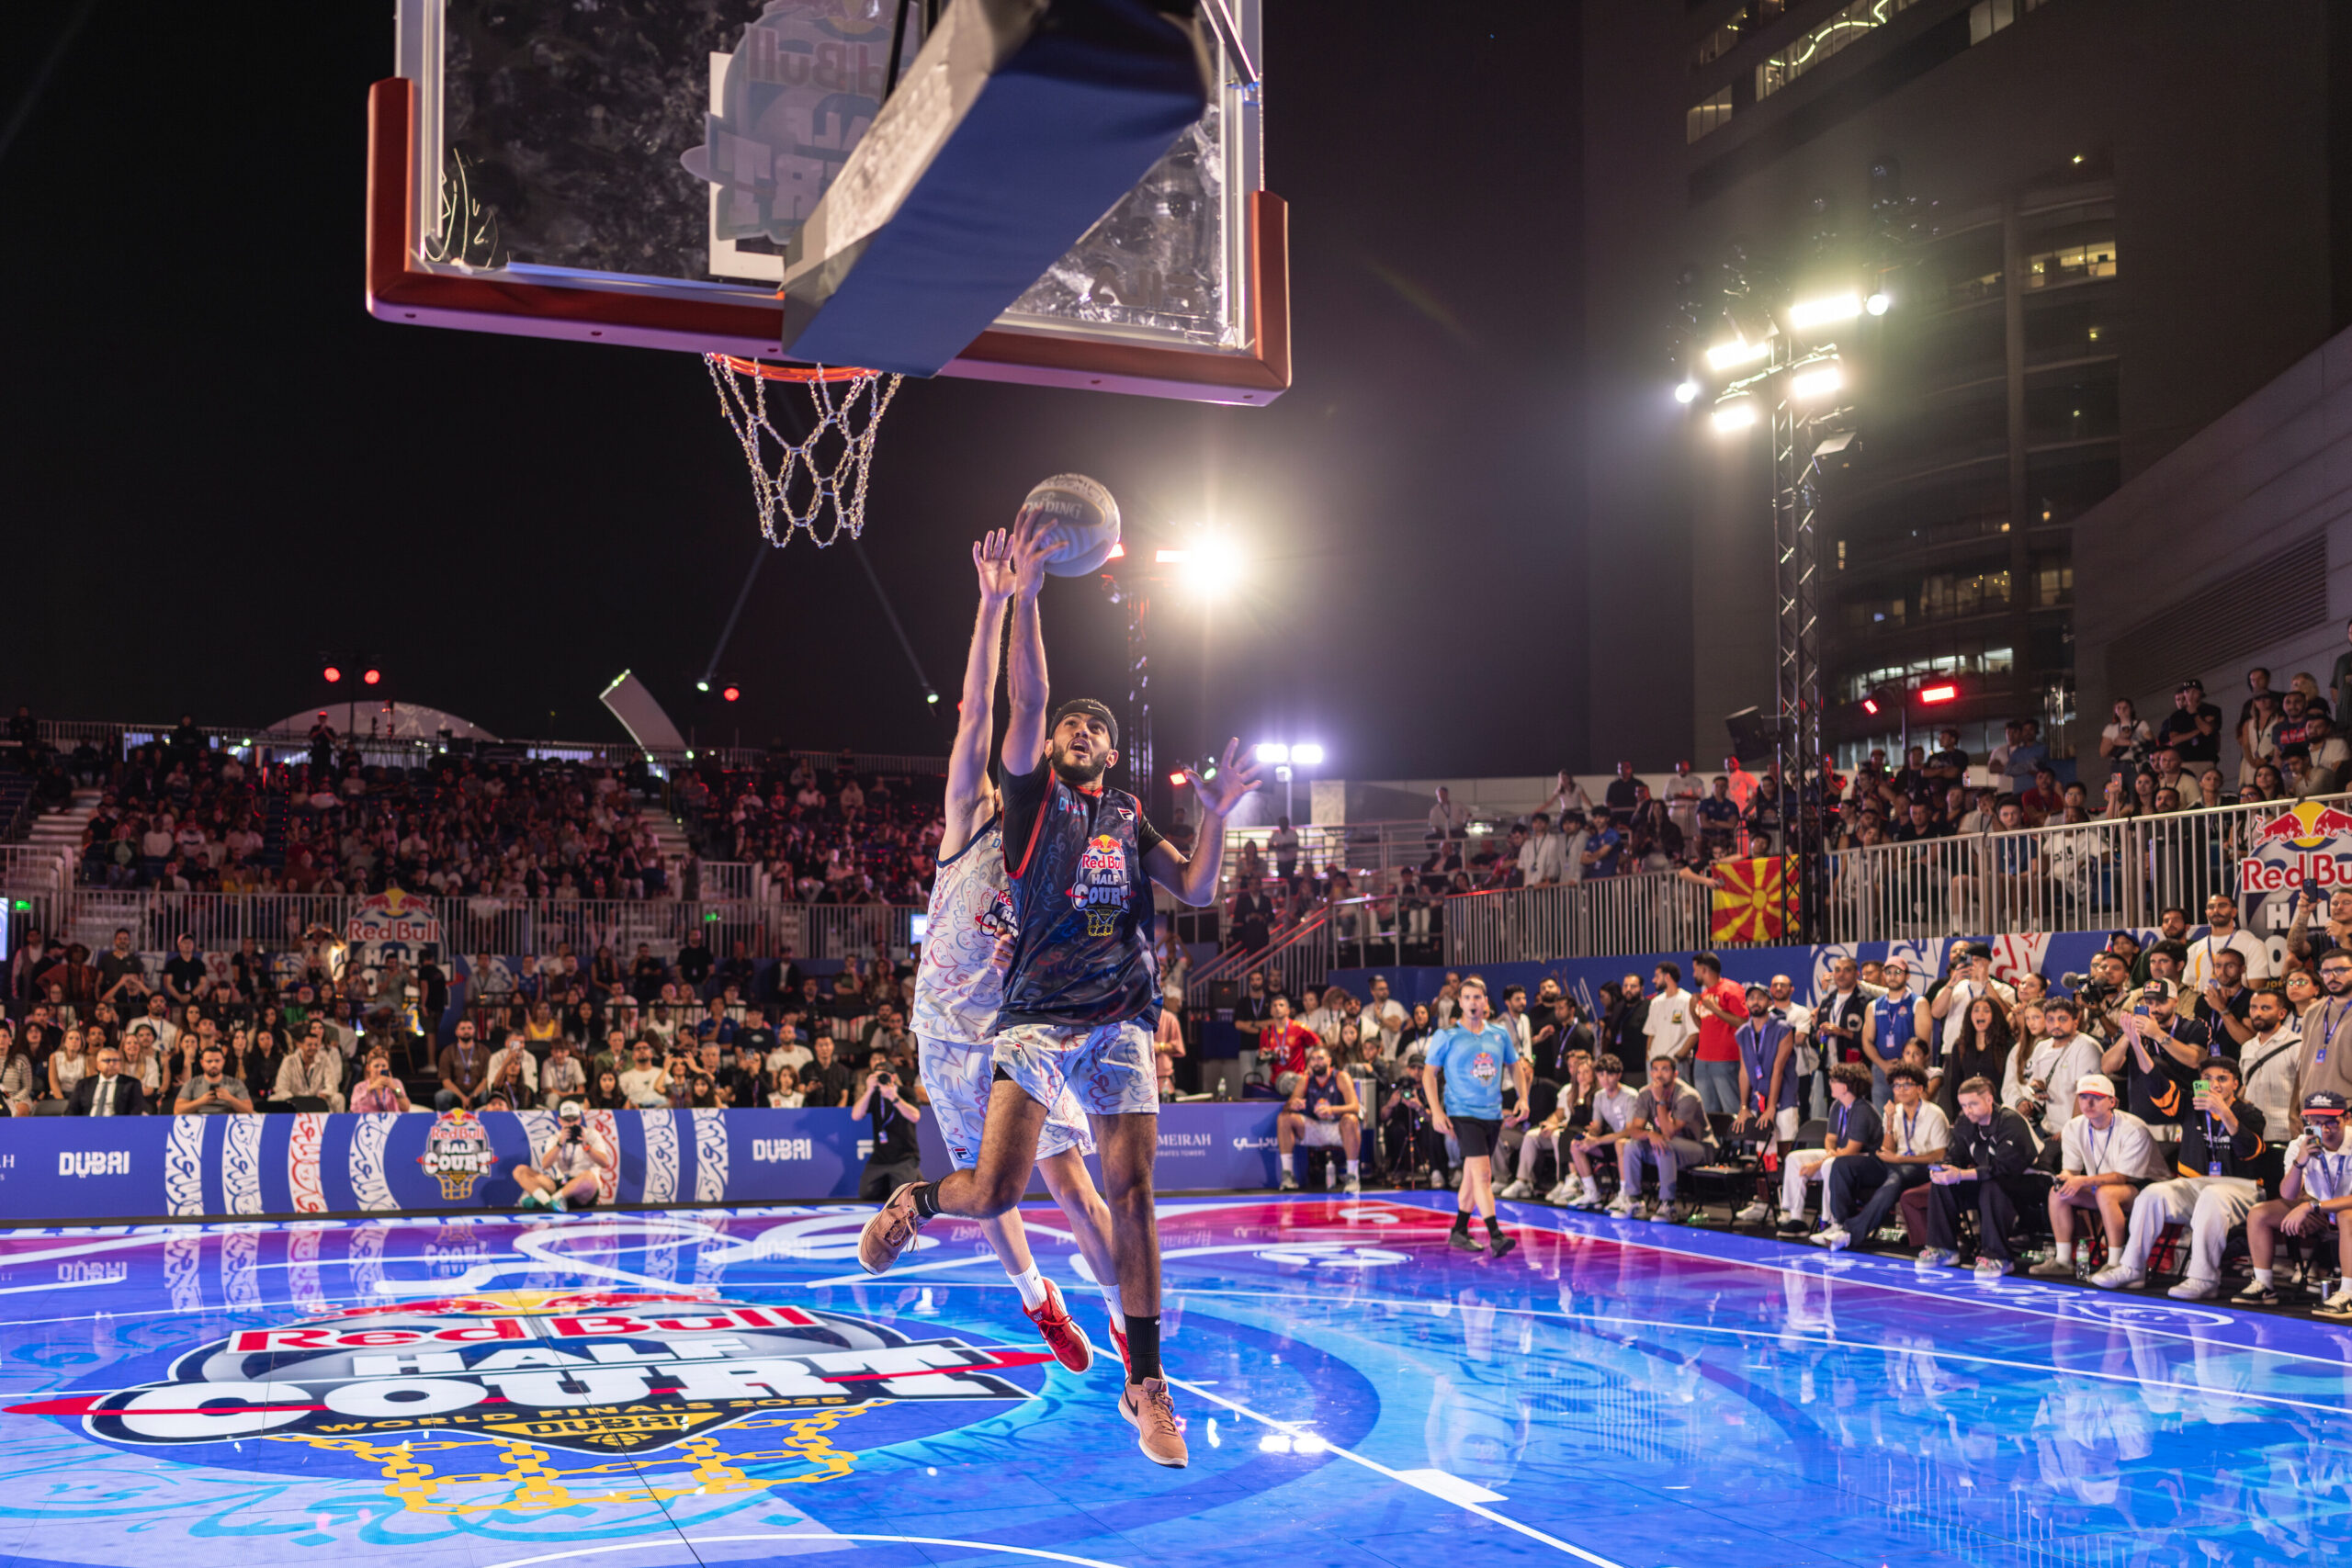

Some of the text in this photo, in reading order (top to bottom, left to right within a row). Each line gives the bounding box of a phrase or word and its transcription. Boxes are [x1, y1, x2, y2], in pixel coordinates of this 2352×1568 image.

[1082, 854, 1125, 870] Red Bull
[2243, 853, 2352, 891] Red Bu
[1091, 874, 1119, 886] HALF
[997, 890, 1012, 907] Re
[1074, 884, 1130, 909] COURT
[348, 919, 439, 941] Red Bull
[1001, 909, 1018, 928] HA
[431, 1126, 484, 1139] Red Bull
[1157, 1134, 1211, 1146] MEIRAH
[441, 1143, 475, 1154] HALF
[752, 1139, 812, 1163] DUBAI
[59, 1151, 130, 1179] DUBAI
[424, 1150, 492, 1175] COURT
[236, 1306, 822, 1351] Red Bull
[353, 1338, 751, 1376] HALF
[121, 1343, 995, 1438] COURT
[317, 1396, 848, 1432] WORLD FINALS 2025
[526, 1415, 689, 1436] DUBAI
